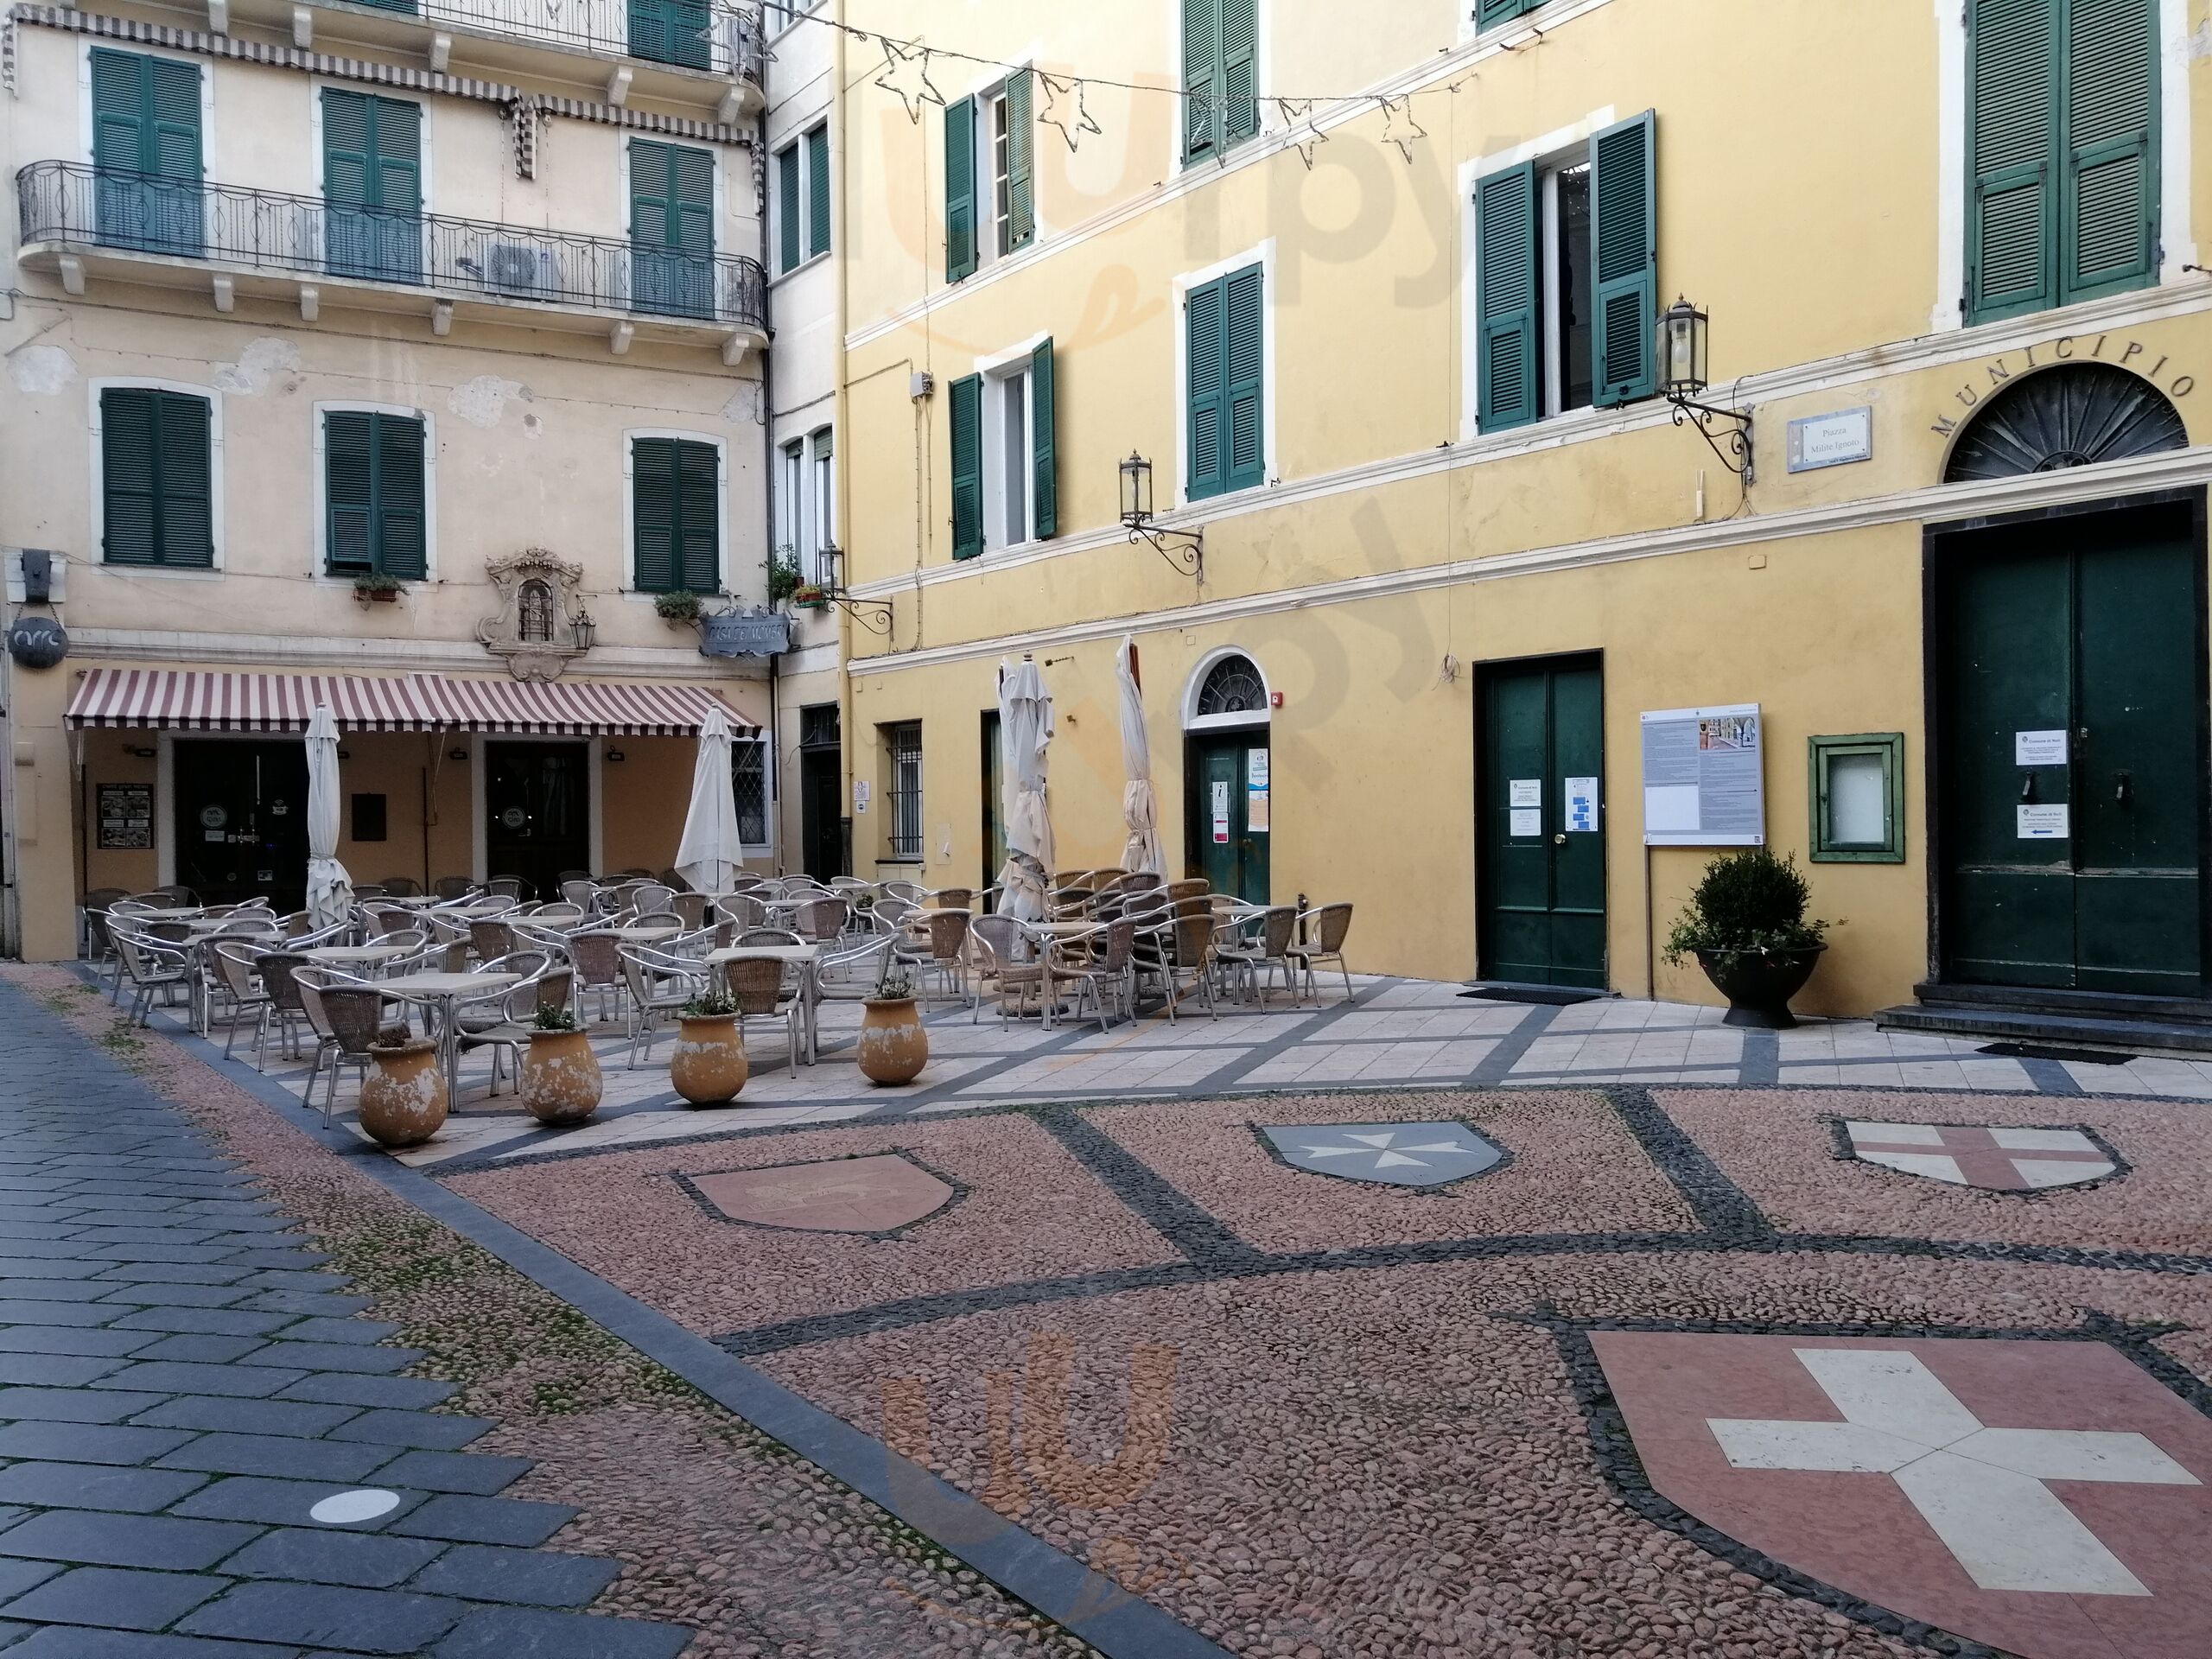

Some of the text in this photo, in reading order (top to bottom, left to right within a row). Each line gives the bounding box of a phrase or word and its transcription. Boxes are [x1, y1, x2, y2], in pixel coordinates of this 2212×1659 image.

[1929, 334, 2195, 439] MUNICIPIO
[1822, 428, 1847, 437] Piazza
[1811, 439, 1859, 454] Milite Ignoto
